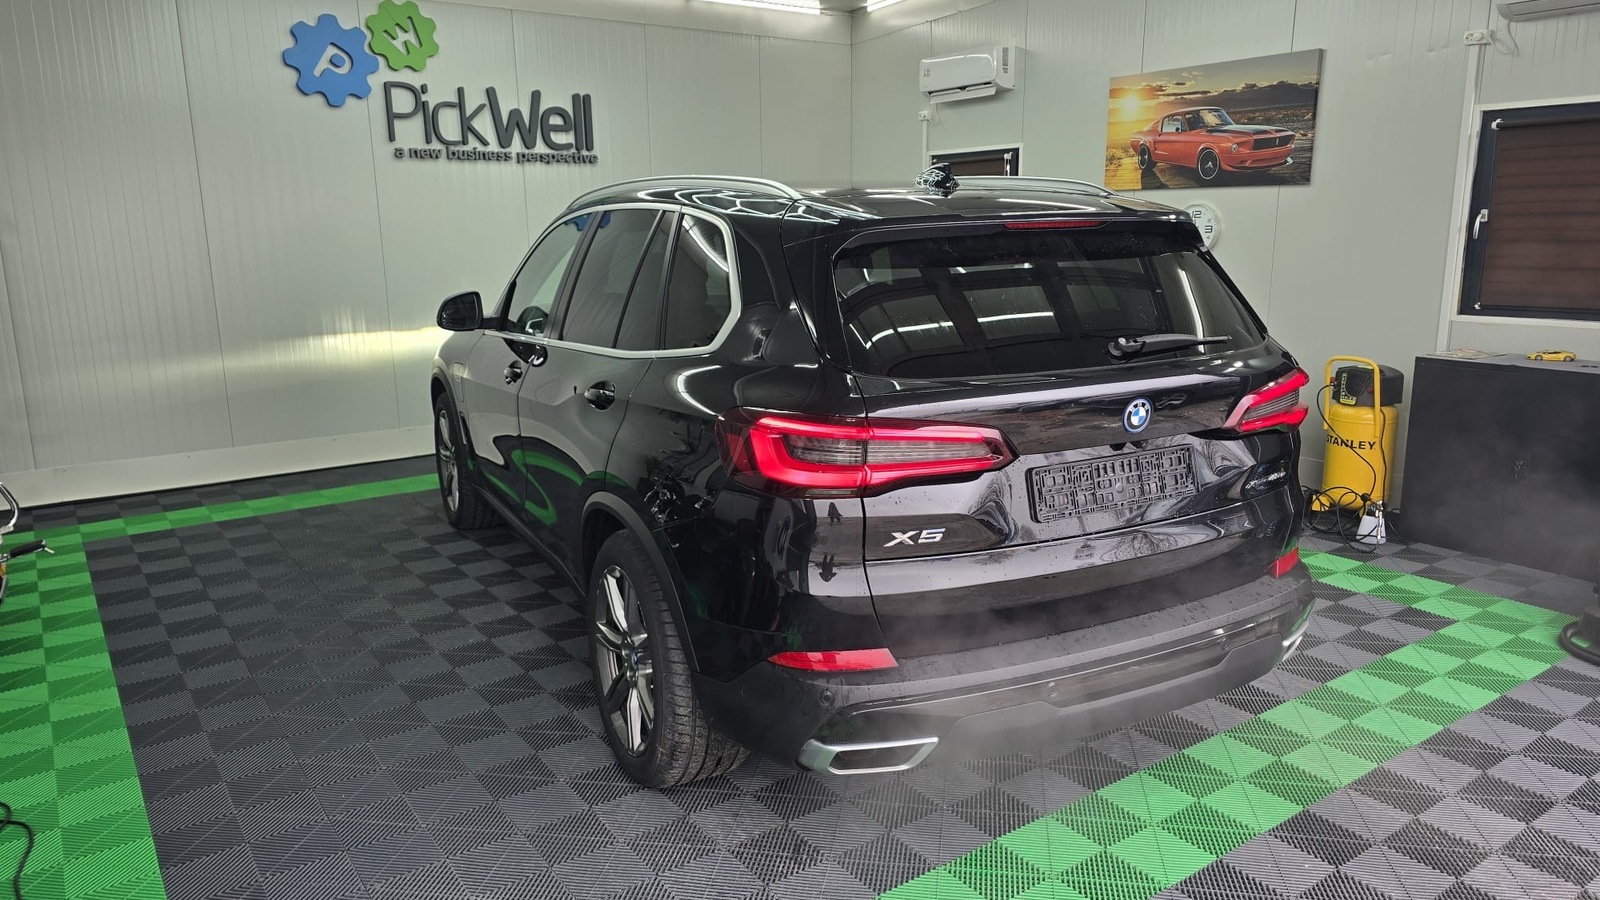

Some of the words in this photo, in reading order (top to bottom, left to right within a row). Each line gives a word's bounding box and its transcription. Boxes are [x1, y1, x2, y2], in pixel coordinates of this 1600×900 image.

[382, 16, 422, 56] W
[313, 42, 354, 79] P
[384, 80, 595, 152] PickWell
[394, 147, 406, 159] a
[409, 147, 443, 160] new
[446, 146, 514, 163] business
[516, 151, 599, 165] perspective
[1326, 433, 1377, 451] STANLEY
[883, 528, 946, 547] X5
